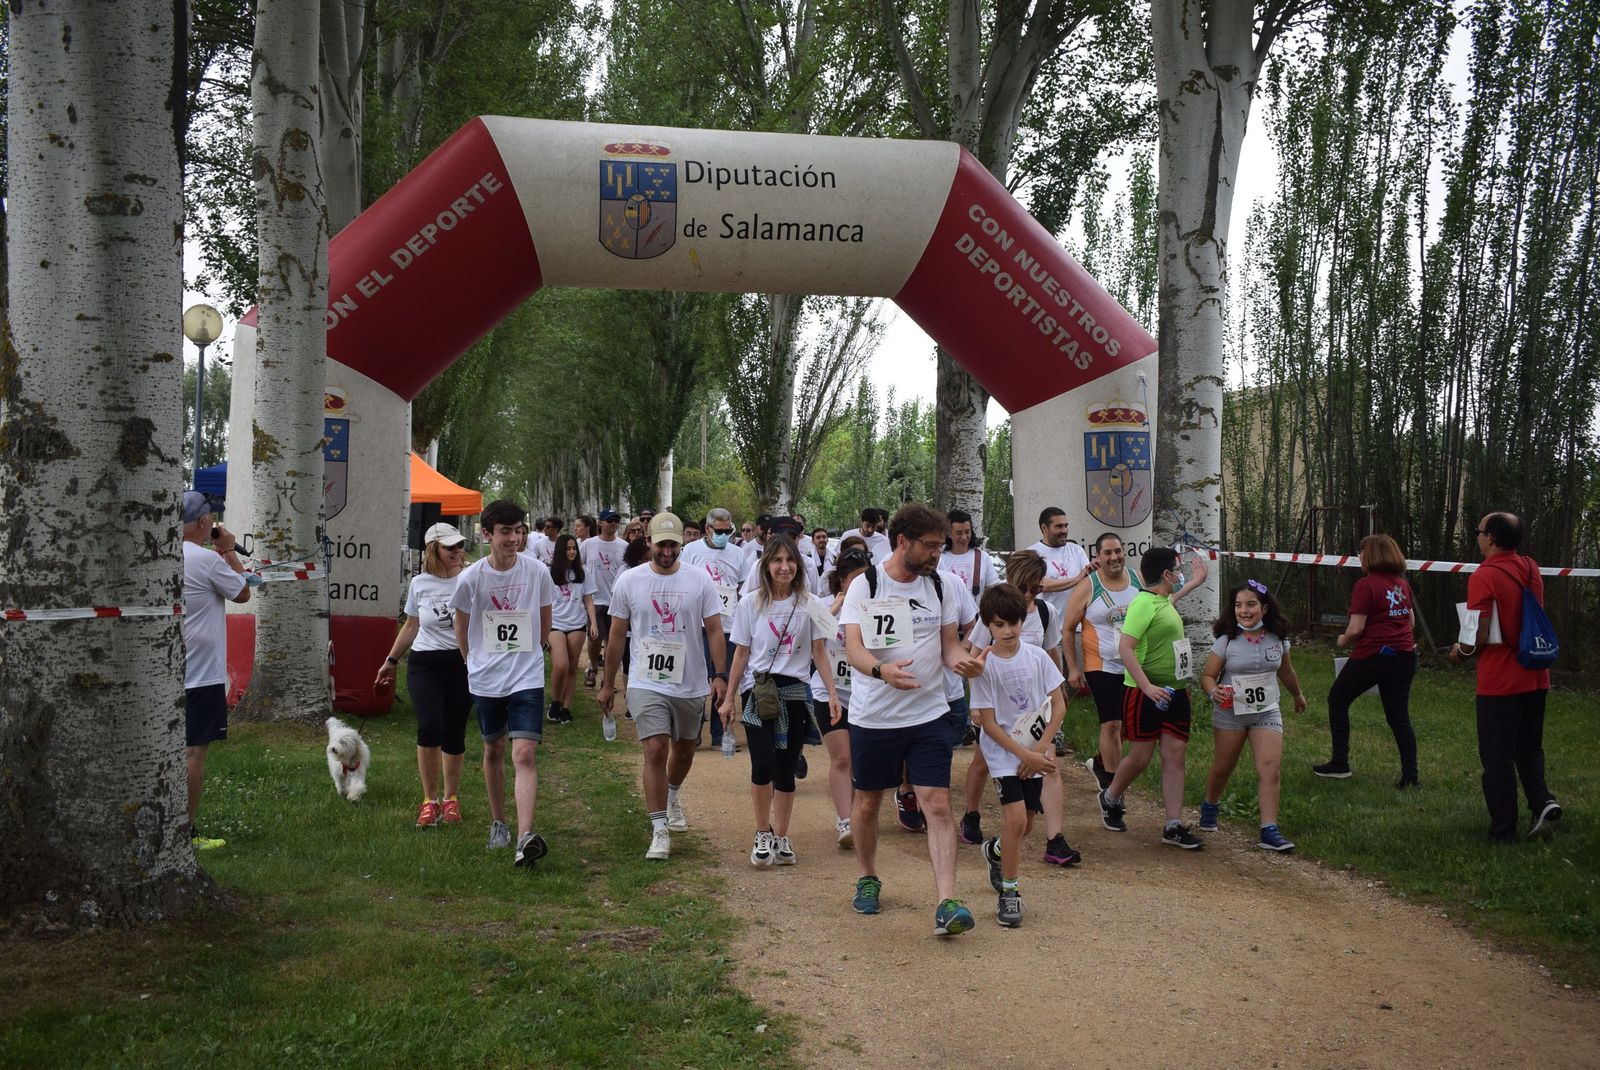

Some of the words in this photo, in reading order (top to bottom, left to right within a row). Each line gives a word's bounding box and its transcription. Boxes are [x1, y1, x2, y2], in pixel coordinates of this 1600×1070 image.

[685, 160, 836, 190] Diputación
[683, 217, 708, 238] de
[719, 213, 864, 243] Salamanca
[325, 294, 359, 331] ON
[355, 270, 394, 299] EL
[390, 172, 503, 270] DEPORTE
[968, 204, 1015, 251] CON
[1013, 249, 1121, 357] NUESTROS
[954, 233, 1093, 370] DEPORTISTAS
[497, 623, 518, 642] 62
[873, 614, 896, 636] 72
[647, 653, 675, 672] 104
[1179, 651, 1189, 670] 35
[1244, 686, 1266, 704] 36
